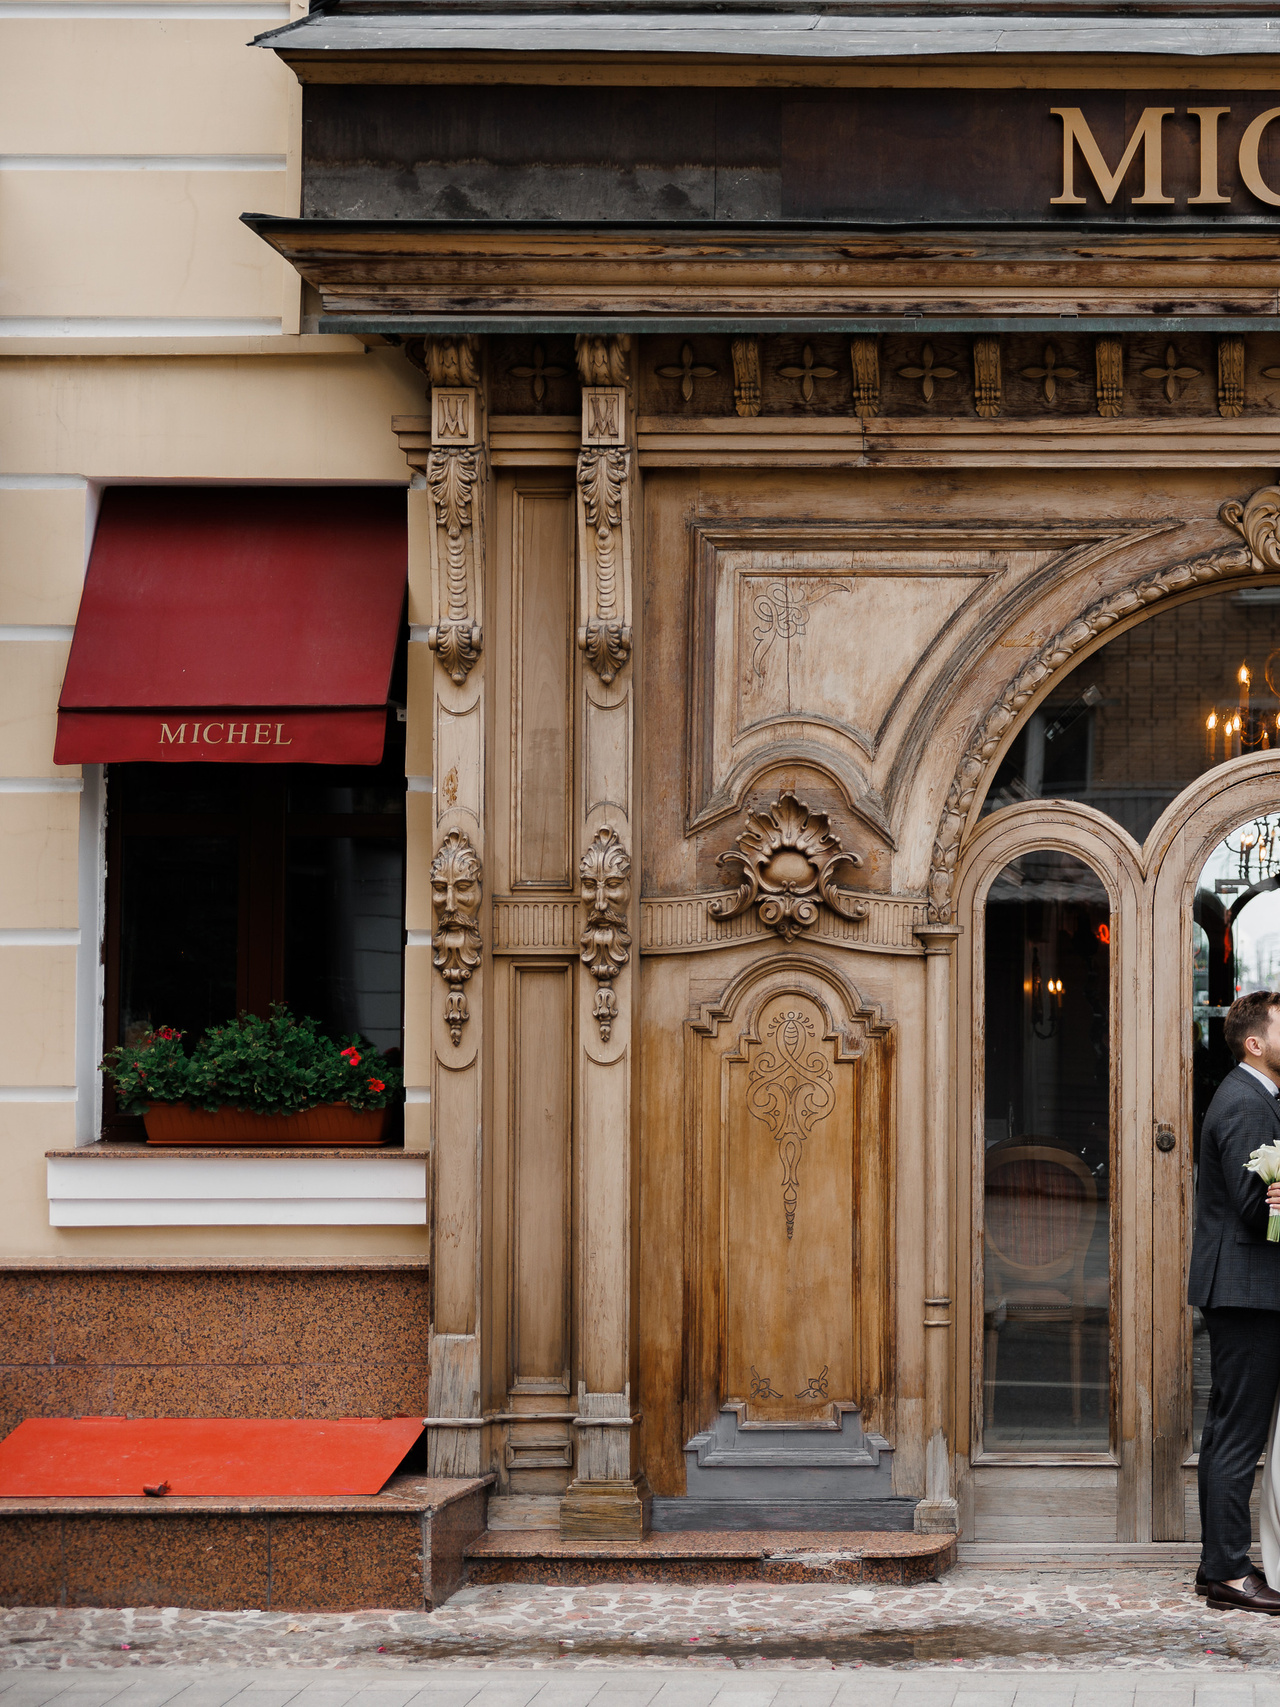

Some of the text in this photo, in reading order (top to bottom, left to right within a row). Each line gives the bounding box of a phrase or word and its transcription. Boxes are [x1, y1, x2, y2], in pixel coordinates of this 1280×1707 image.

[439, 397, 468, 435] M
[590, 397, 619, 435] M
[158, 723, 293, 745] MICHEL
